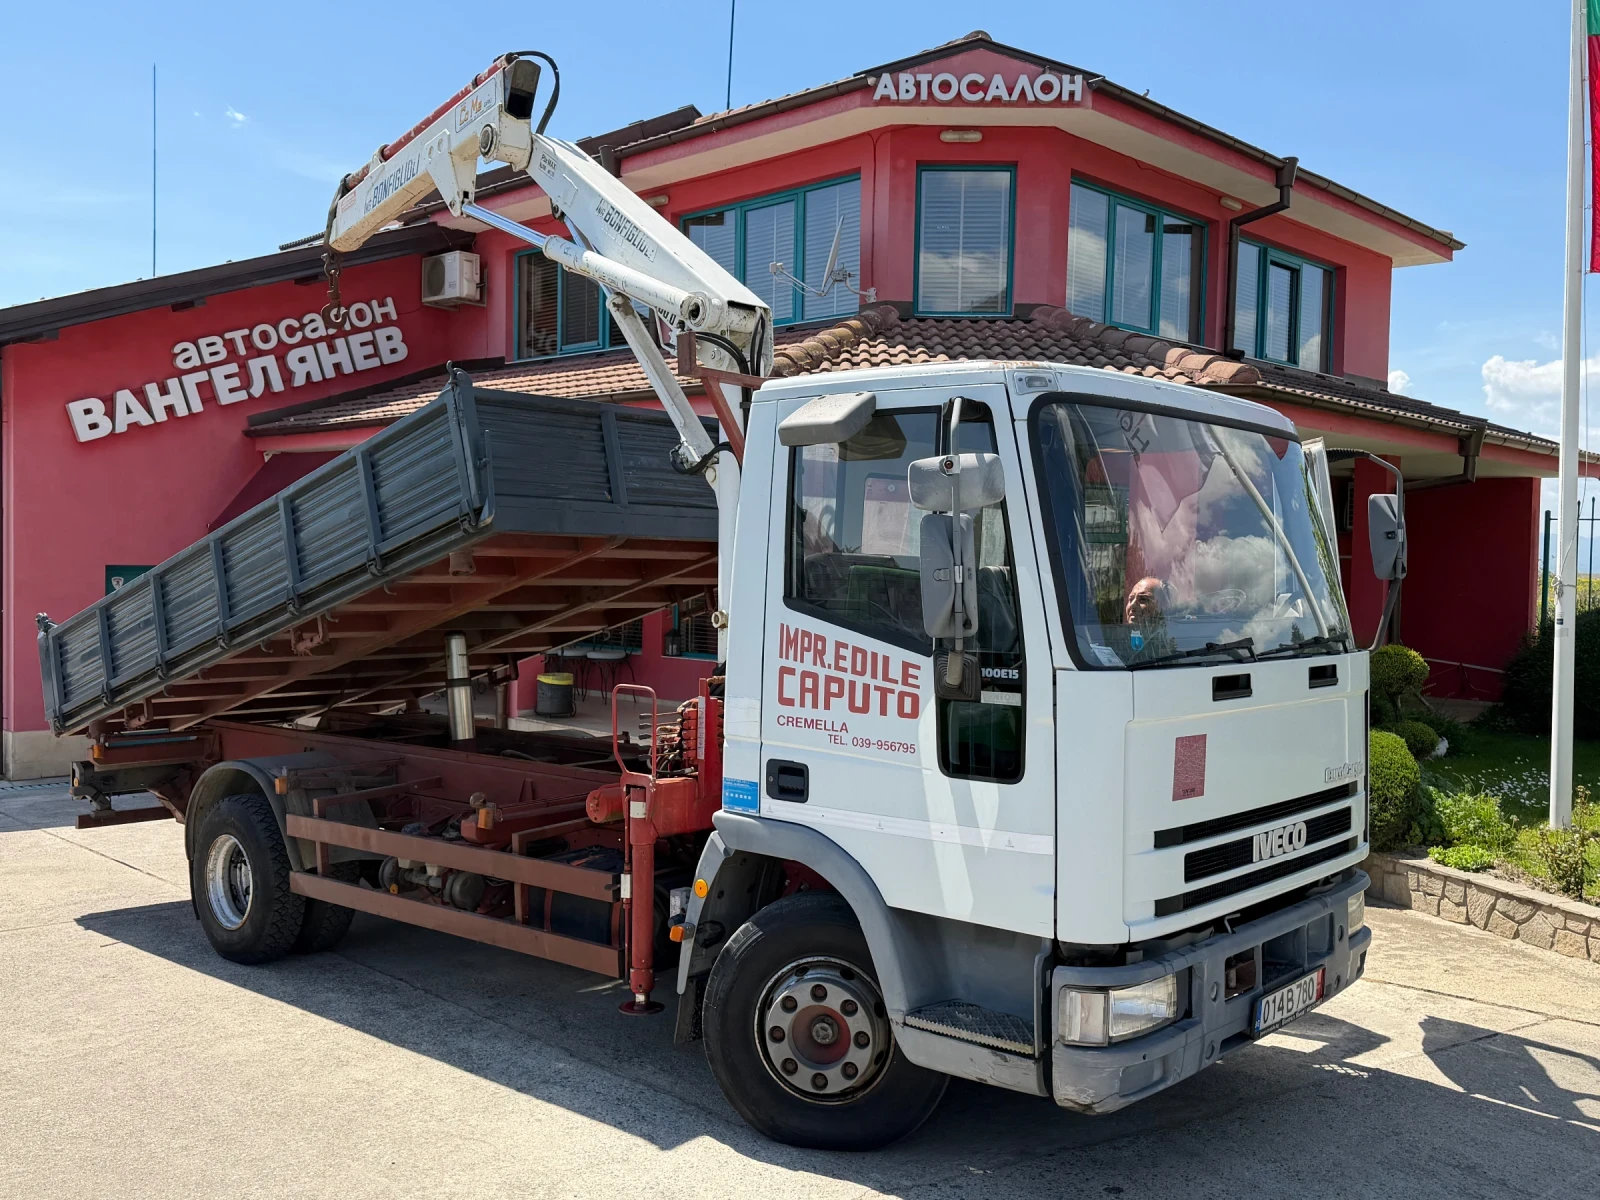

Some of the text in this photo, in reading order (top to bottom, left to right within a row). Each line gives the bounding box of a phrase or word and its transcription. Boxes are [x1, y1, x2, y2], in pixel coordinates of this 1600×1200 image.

[873, 72, 1083, 103] АВТОСАЛОН
[65, 325, 409, 443] ВАНГЕЛ ЯНЕВ
[981, 667, 1019, 679] 100E15
[777, 665, 920, 720] CAPUTO
[776, 714, 849, 734] CREMELLA
[828, 733, 916, 754] TEL. 039-956795
[1252, 820, 1307, 863] IVECO
